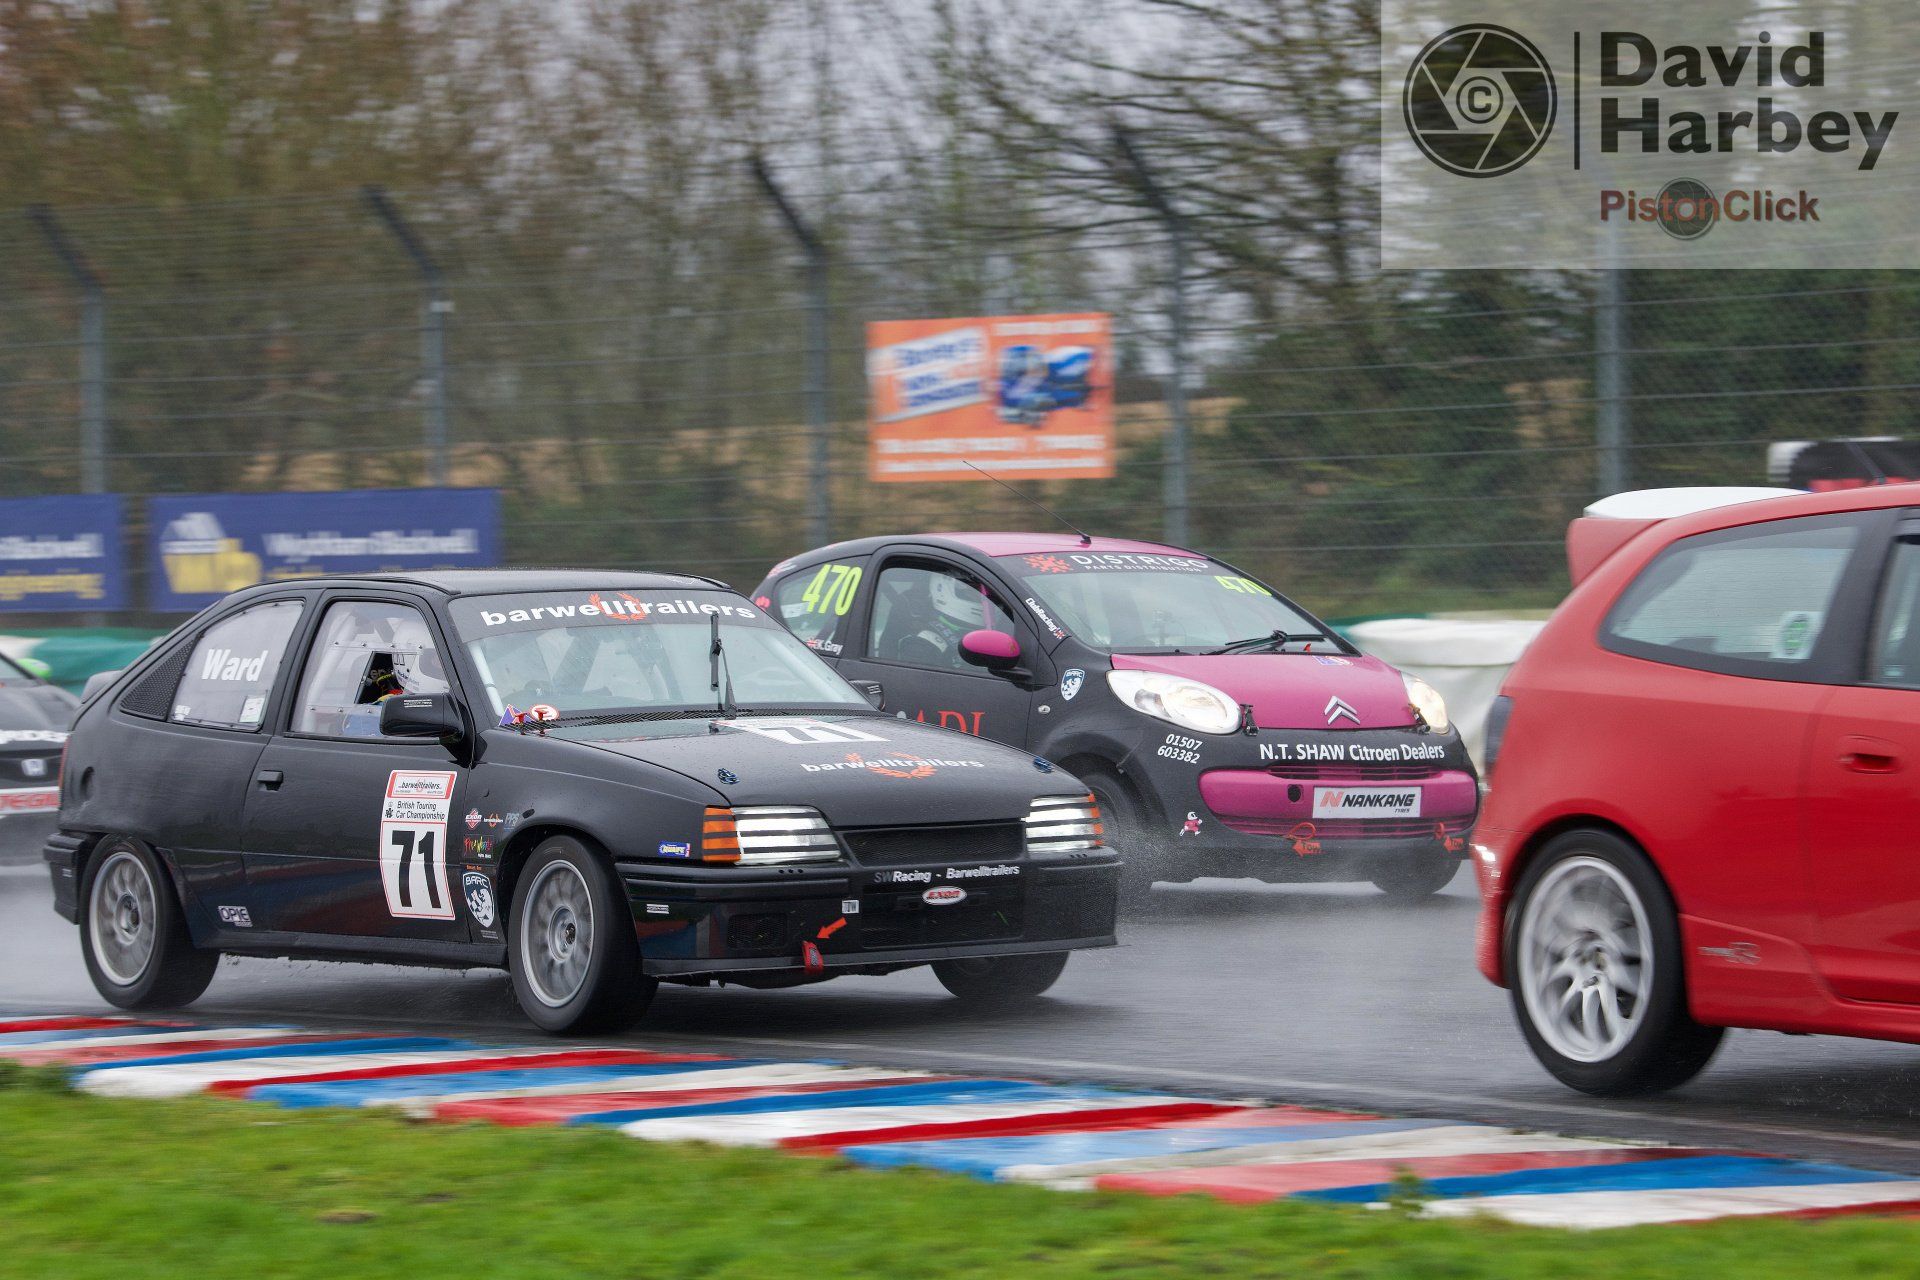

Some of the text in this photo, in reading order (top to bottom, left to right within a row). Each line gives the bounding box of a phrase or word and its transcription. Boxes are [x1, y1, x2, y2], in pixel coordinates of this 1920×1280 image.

[1070, 555, 1208, 569] DISTRIGO
[802, 564, 862, 615] 470
[480, 599, 756, 627] barwelltrailers
[202, 649, 268, 681] Ward
[758, 726, 865, 742] 71
[1165, 733, 1202, 750] 01507
[1157, 745, 1200, 764] 603382
[1260, 743, 1445, 761] N.T. SHAW Citroen Dealers
[397, 801, 437, 811] British Touring
[1342, 794, 1415, 808] NANKANG
[396, 811, 446, 821] Car Championship
[391, 830, 442, 909] 71
[466, 875, 489, 888] BARC
